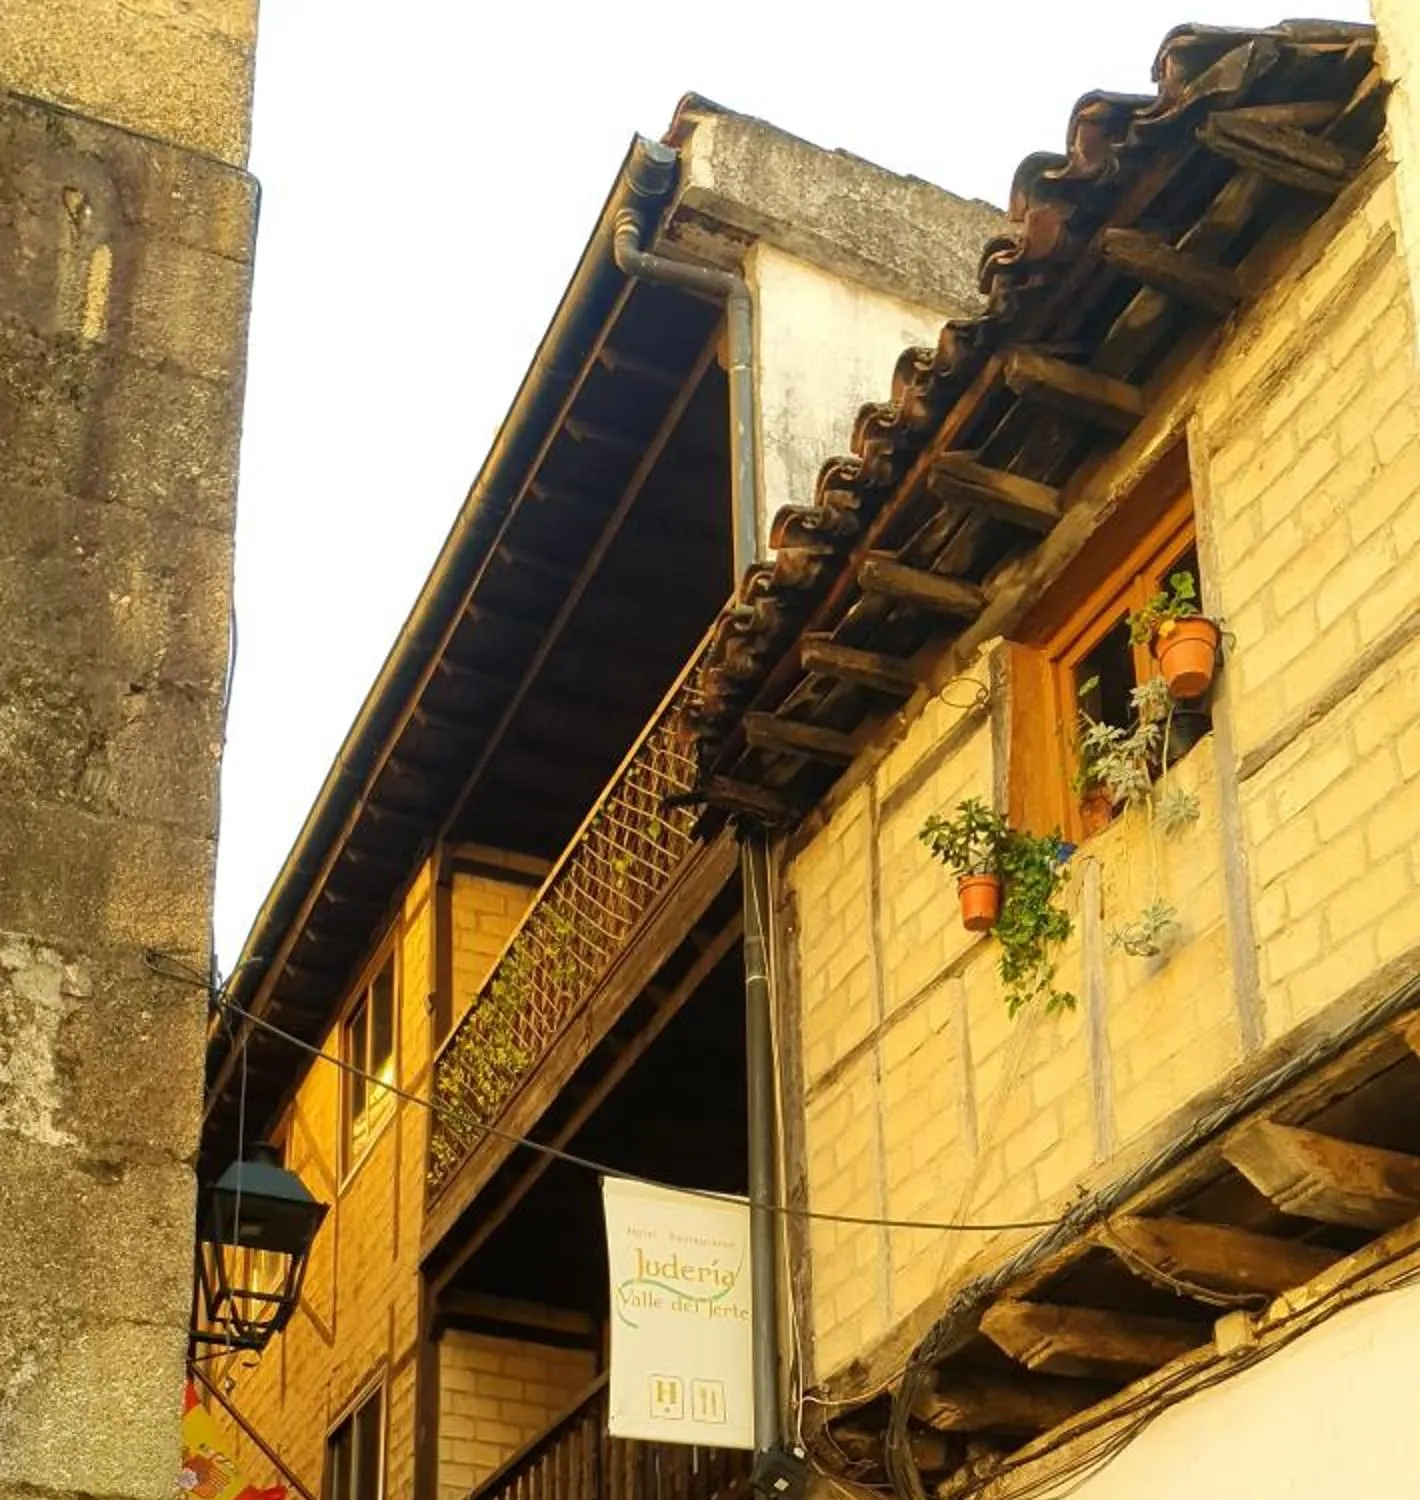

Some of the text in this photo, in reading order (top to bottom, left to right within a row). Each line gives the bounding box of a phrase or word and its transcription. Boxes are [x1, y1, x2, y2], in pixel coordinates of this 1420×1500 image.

[634, 1247, 736, 1287] Judería
[617, 1287, 750, 1321] Valle del Jerte
